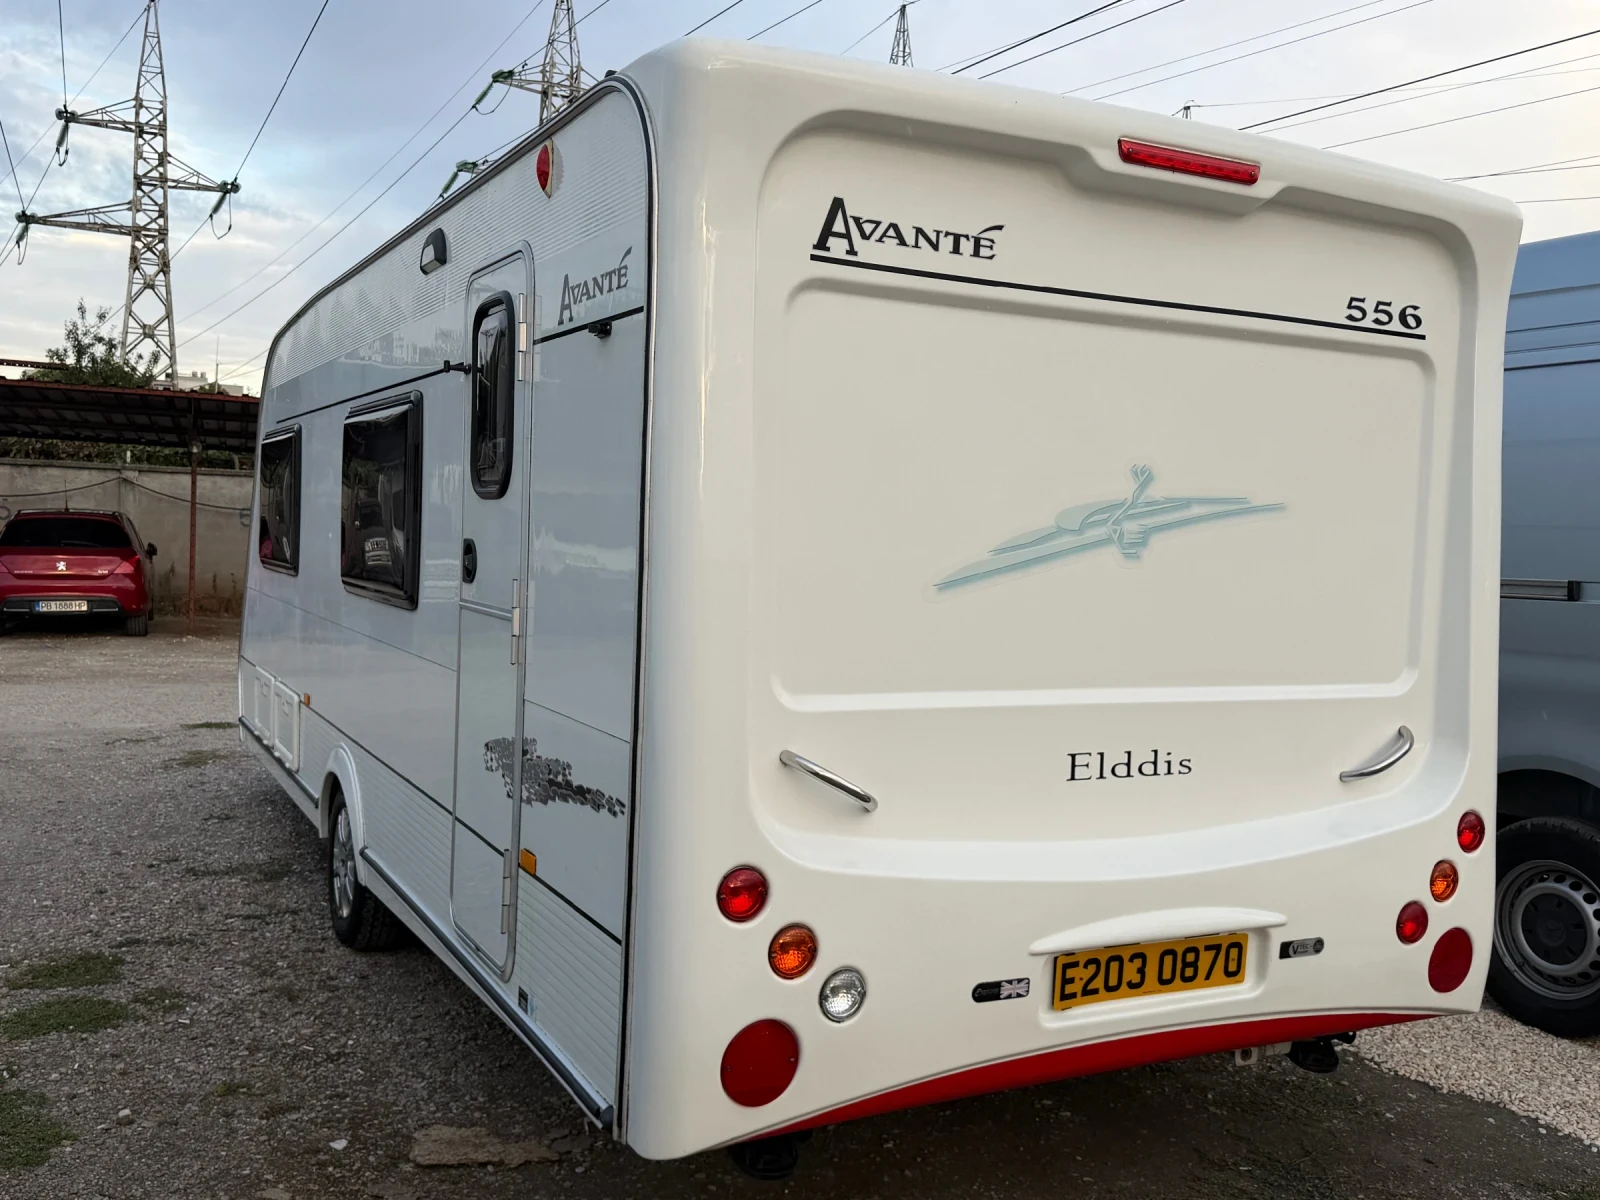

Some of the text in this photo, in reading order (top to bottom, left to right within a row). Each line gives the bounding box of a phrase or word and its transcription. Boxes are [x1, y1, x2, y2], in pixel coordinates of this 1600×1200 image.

[1344, 296, 1423, 330] 556
[1066, 749, 1192, 781] Elddis
[1059, 941, 1244, 1002] E203 0870
